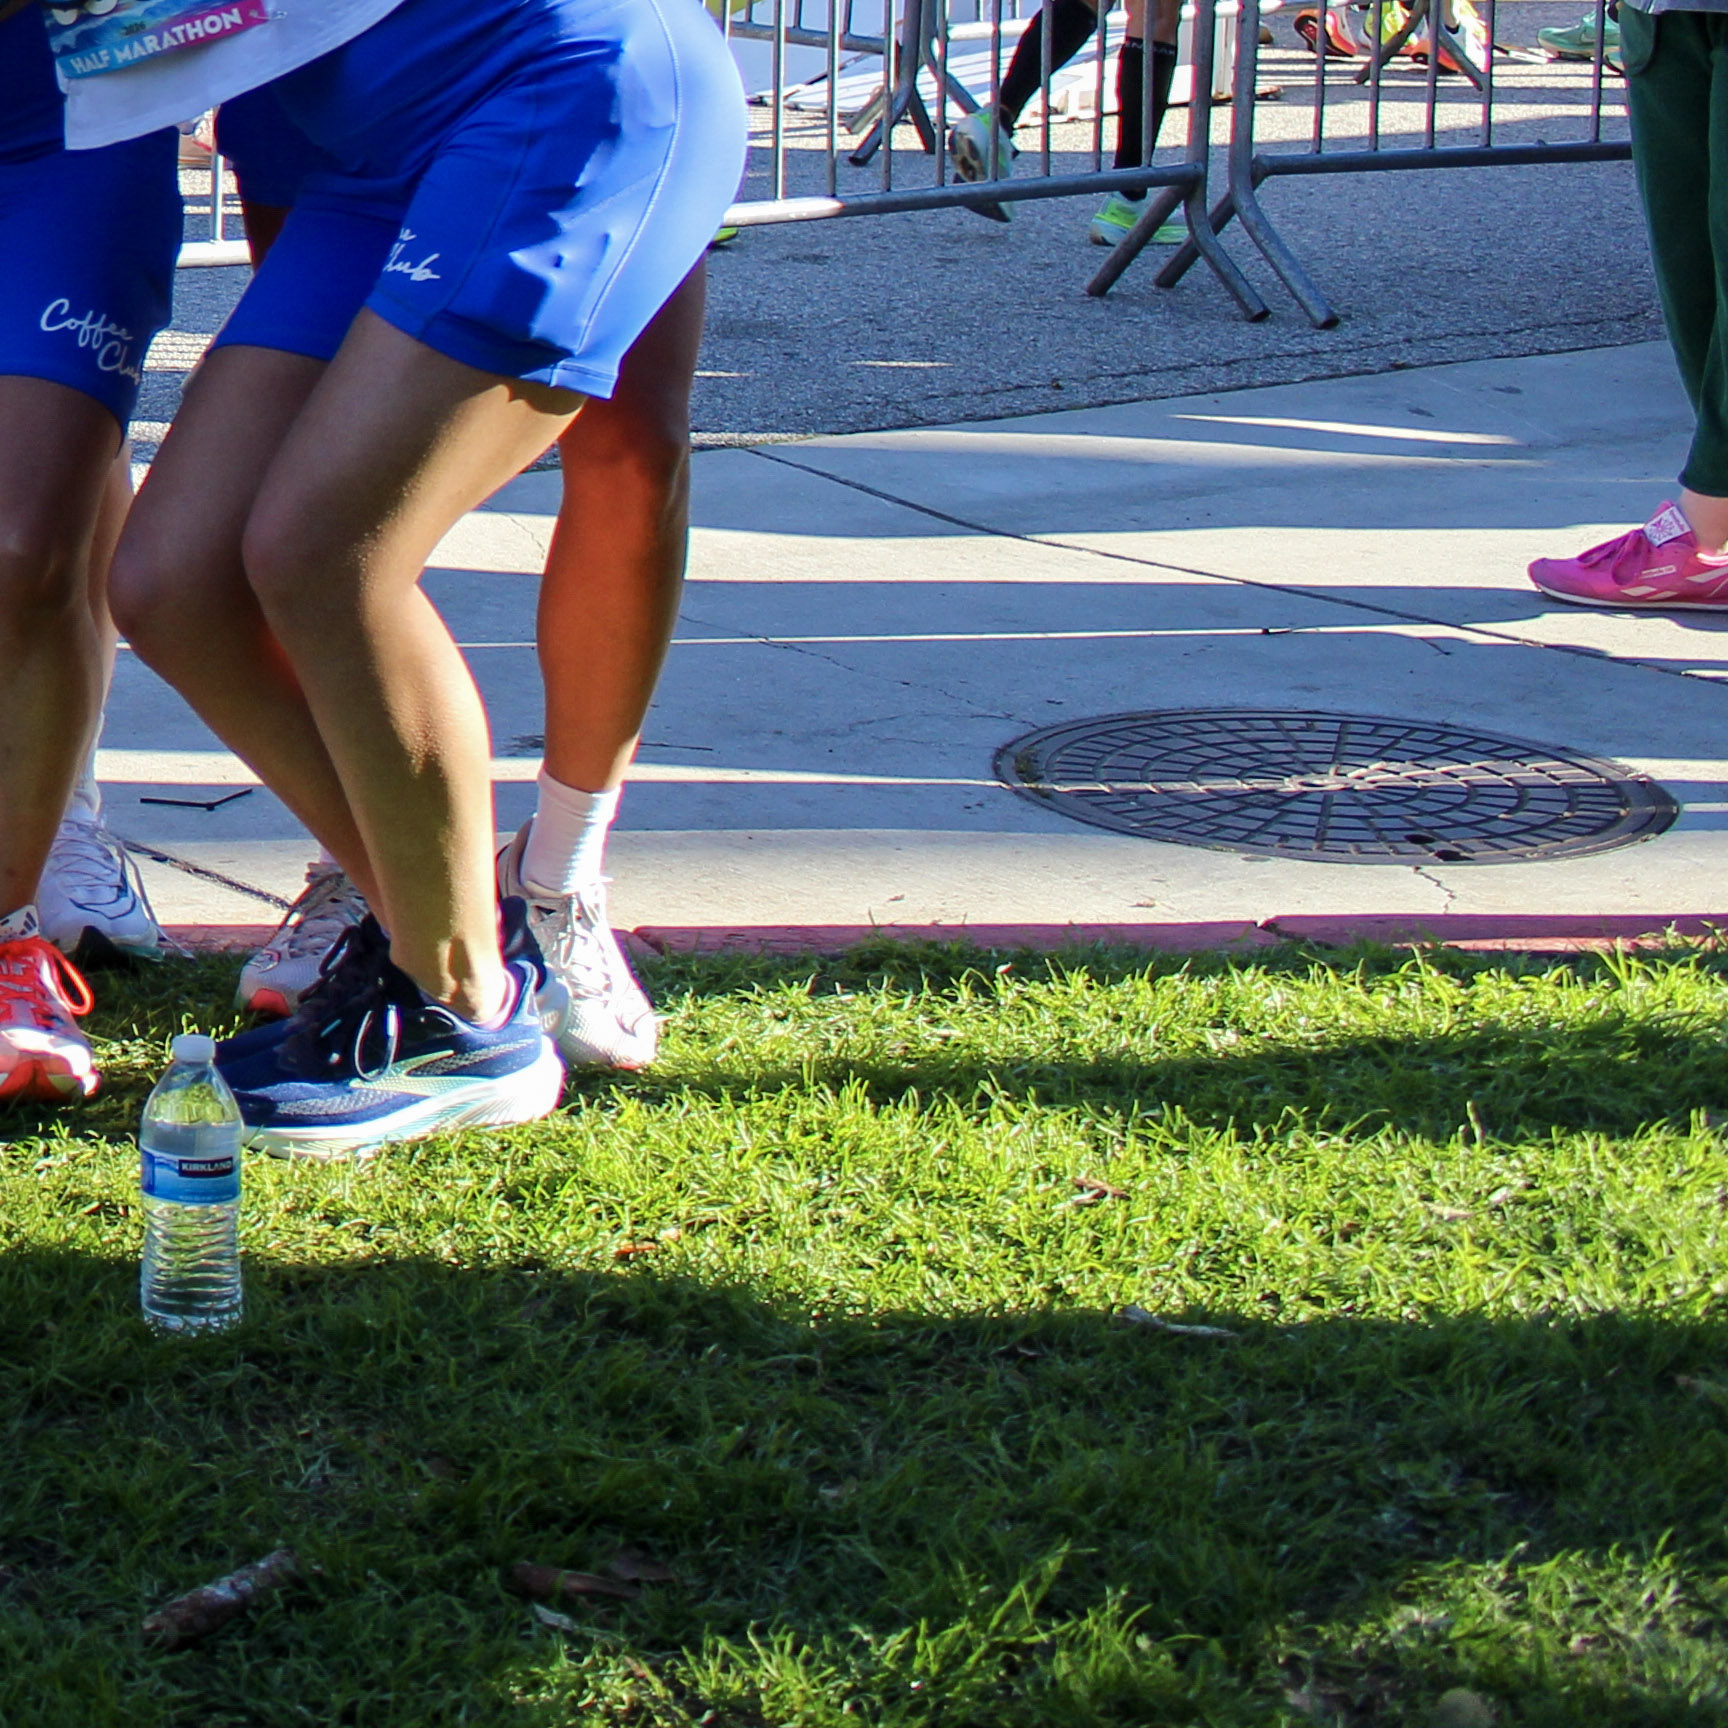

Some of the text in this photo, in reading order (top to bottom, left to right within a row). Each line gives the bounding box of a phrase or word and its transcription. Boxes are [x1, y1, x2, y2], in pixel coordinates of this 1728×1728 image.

[69, 8, 244, 75] HALF MARATHON
[40, 298, 135, 349] Coffee
[181, 1159, 233, 1172] KIRKLAND
